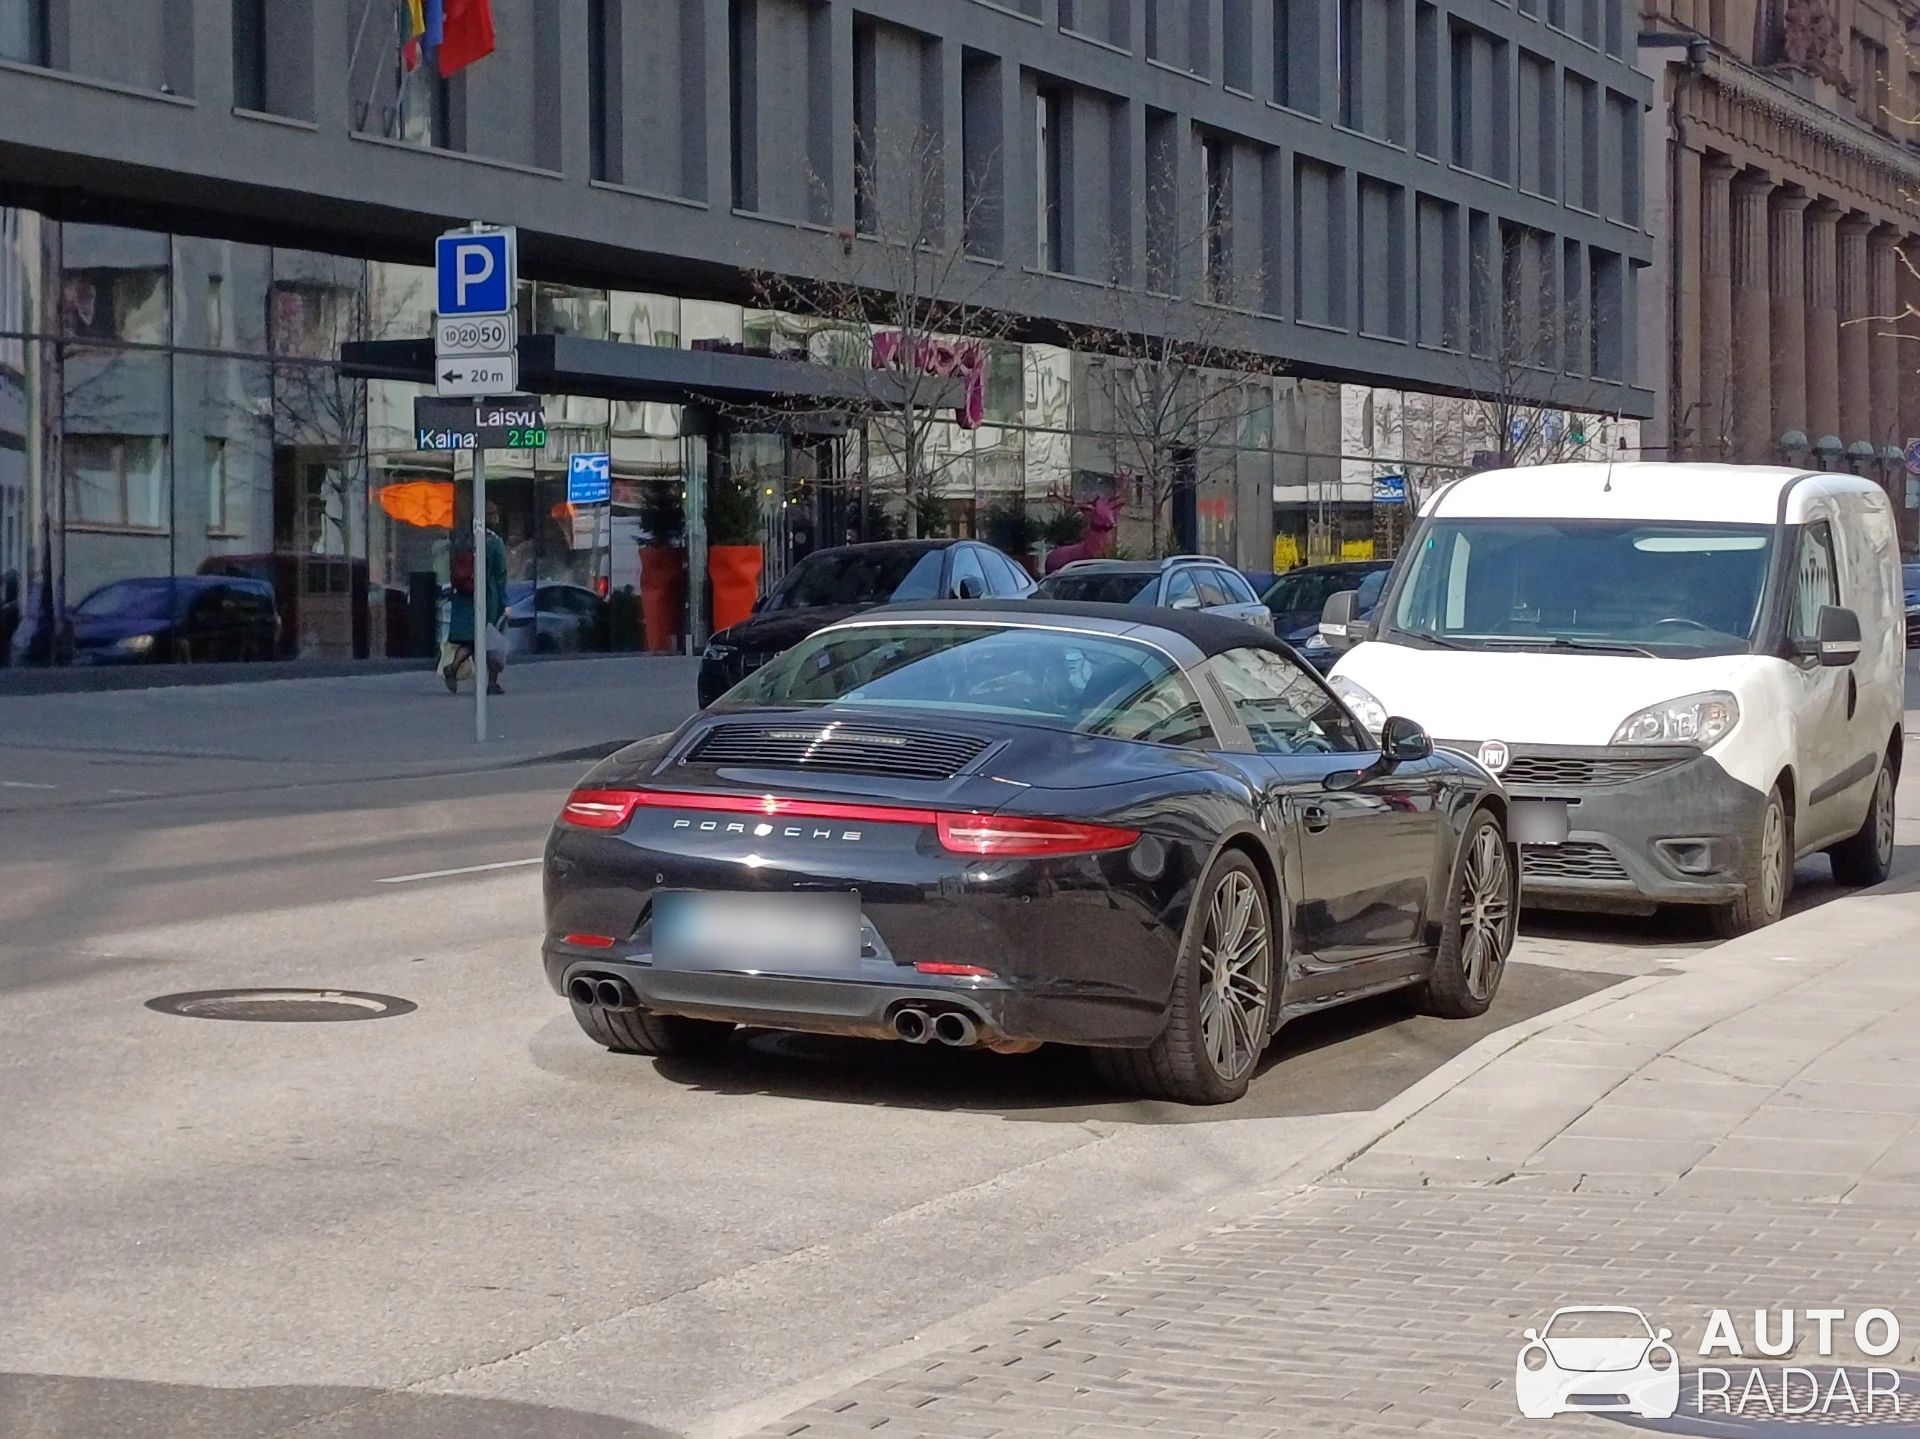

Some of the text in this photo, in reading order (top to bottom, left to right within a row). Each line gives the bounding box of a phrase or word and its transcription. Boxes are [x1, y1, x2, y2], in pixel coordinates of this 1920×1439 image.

[456, 244, 494, 306] P
[446, 326, 502, 343] 10 20 50
[471, 369, 504, 383] 20 m
[1484, 750, 1504, 765] FIAT
[673, 819, 862, 841] PORCHE
